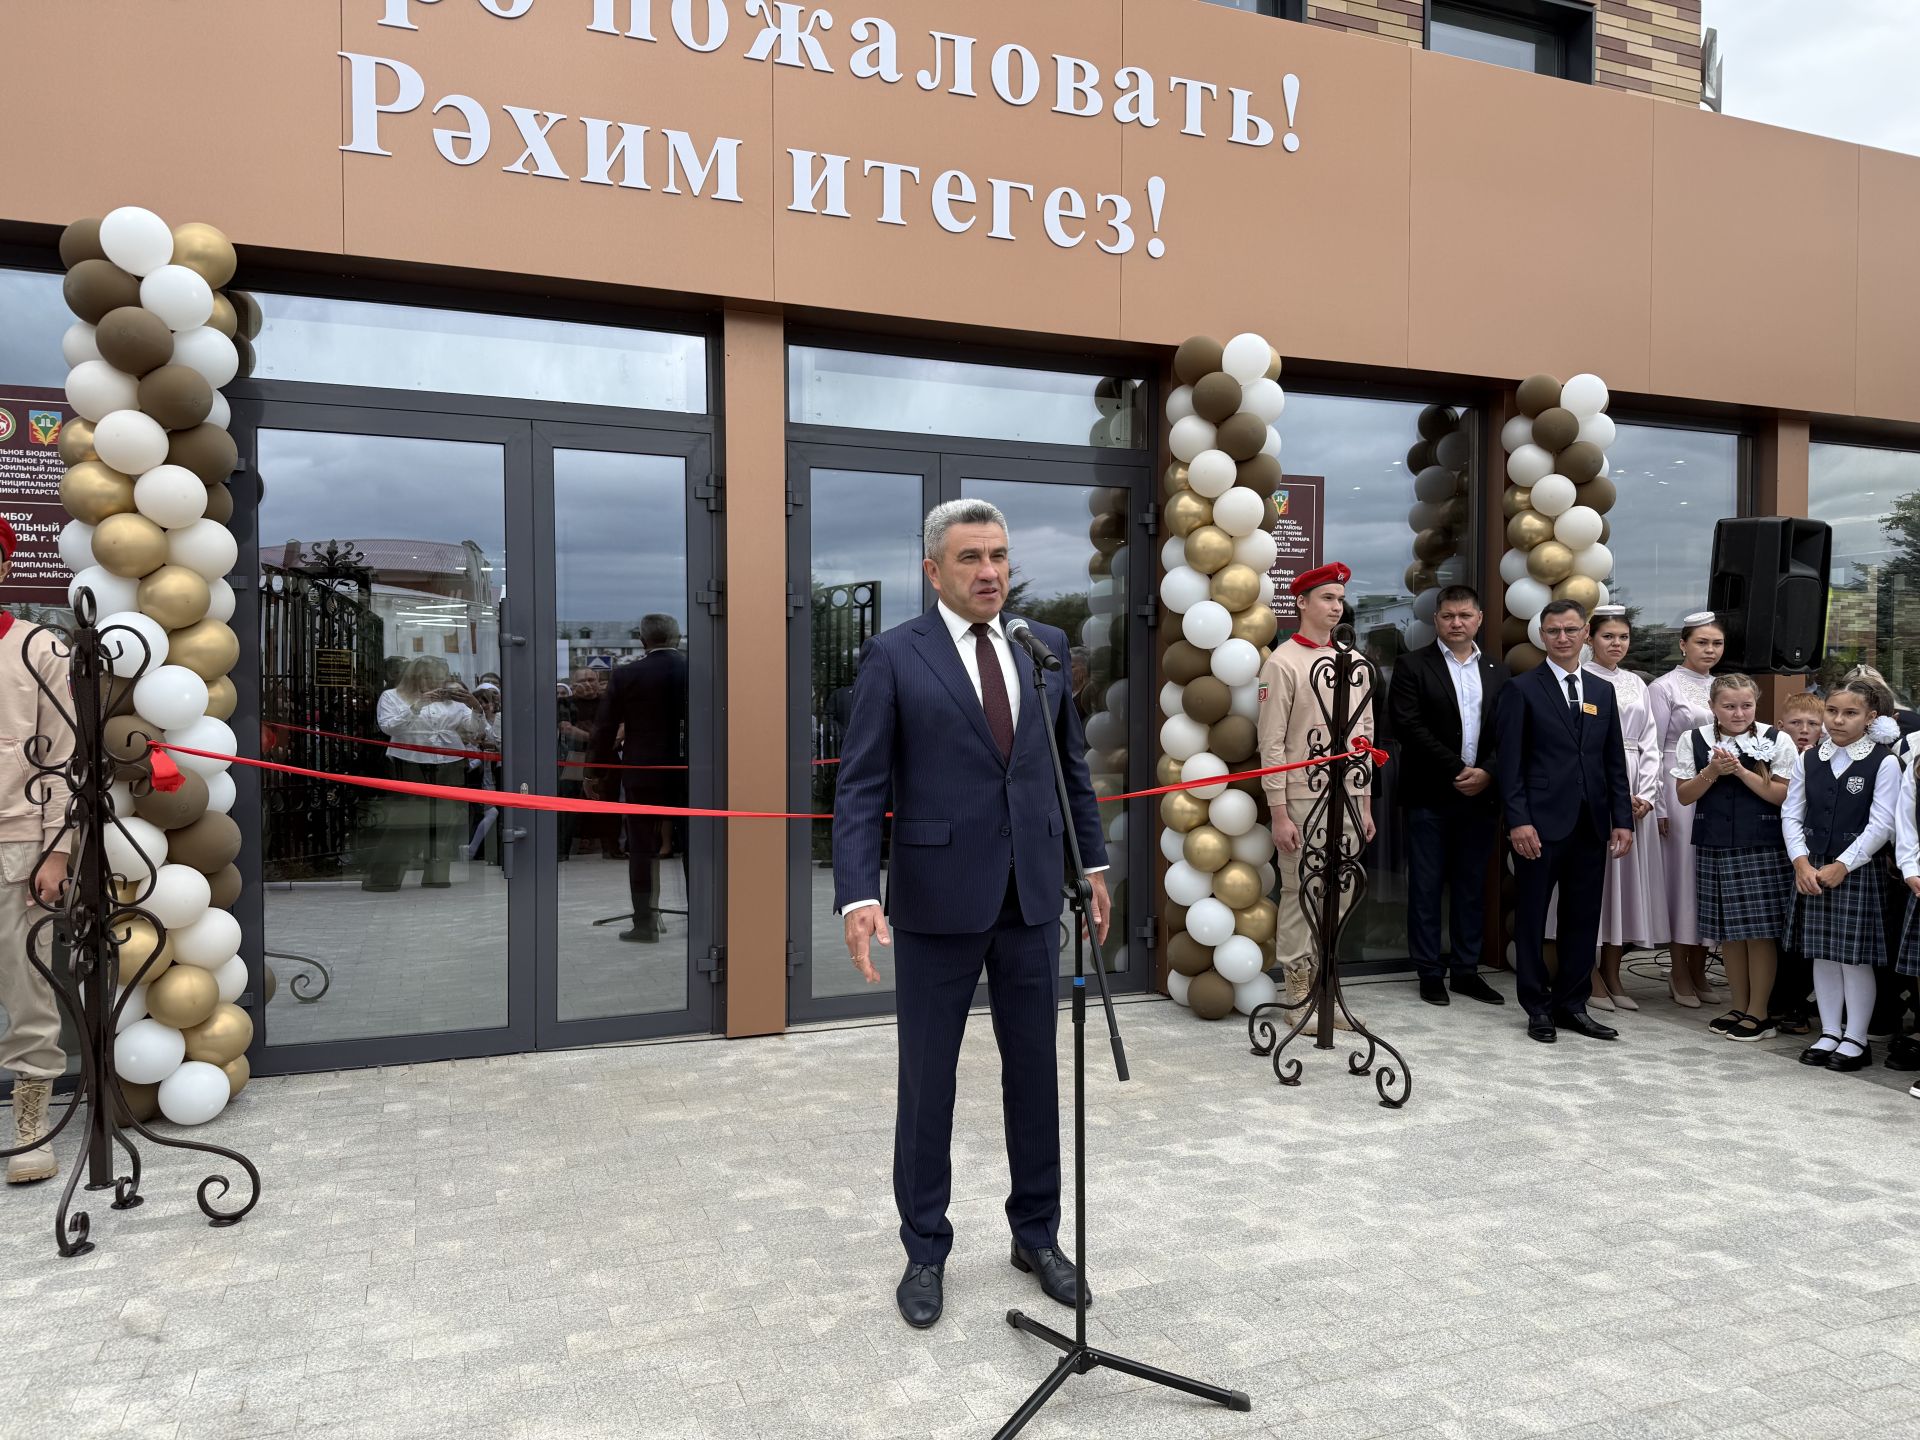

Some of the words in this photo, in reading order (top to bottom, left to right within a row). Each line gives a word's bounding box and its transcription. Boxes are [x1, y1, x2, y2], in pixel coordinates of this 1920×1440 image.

[337, 51, 744, 203] Рәхим
[786, 148, 1166, 258] итегез!
[0, 513, 33, 521] МБОУ
